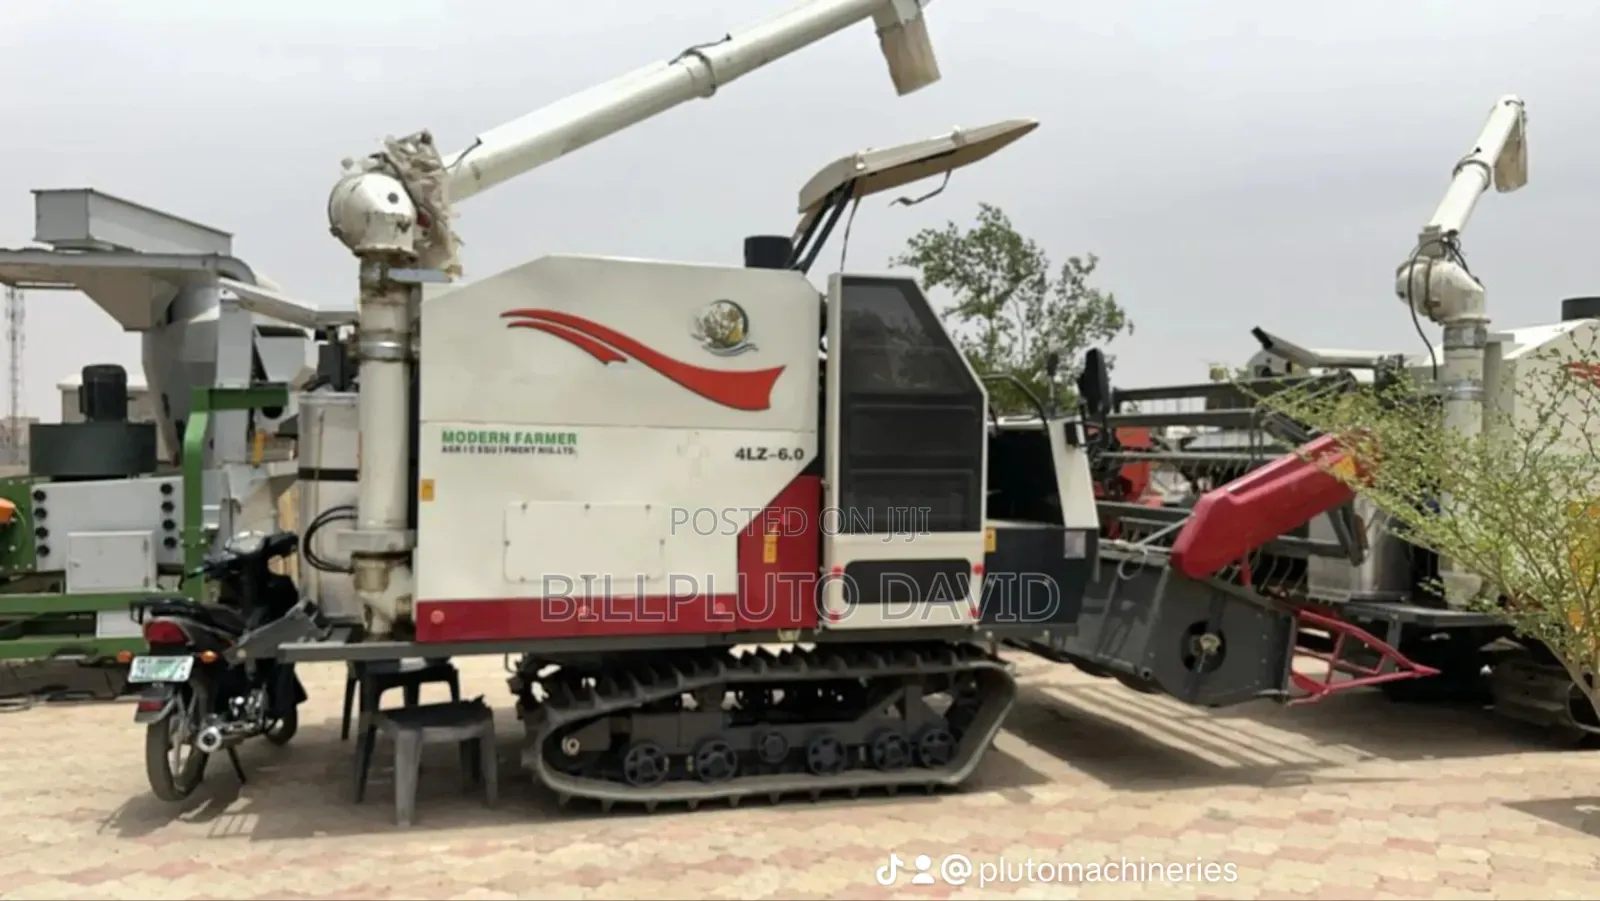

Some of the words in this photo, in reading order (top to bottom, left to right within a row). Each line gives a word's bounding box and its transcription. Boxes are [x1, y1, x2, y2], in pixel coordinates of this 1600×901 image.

[442, 431, 510, 444] MODERN
[514, 432, 577, 445] FARMER
[735, 447, 804, 461] 4LZ-6.0
